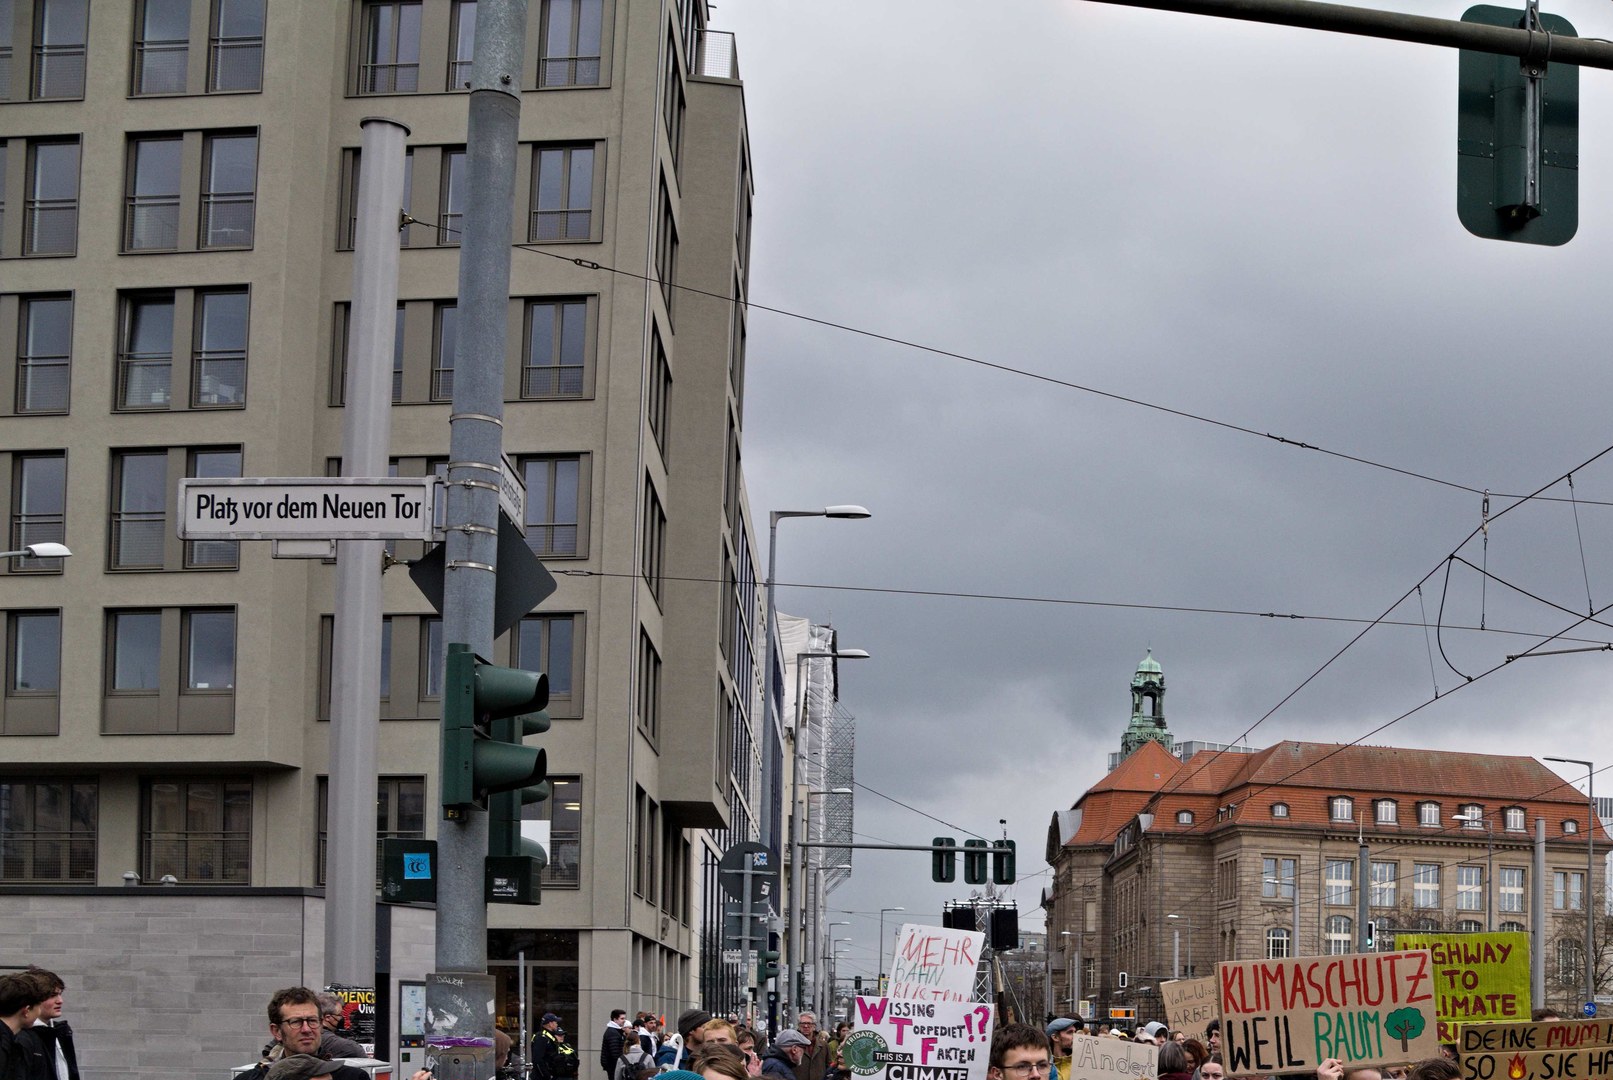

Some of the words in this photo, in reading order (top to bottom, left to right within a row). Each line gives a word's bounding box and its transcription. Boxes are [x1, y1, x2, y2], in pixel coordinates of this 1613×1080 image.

[196, 493, 238, 525] Platz
[243, 498, 272, 519] vor
[276, 493, 317, 519] dem
[322, 493, 386, 519] Neuen
[391, 493, 421, 519] Tor
[902, 932, 975, 969] MEHR
[894, 957, 944, 986] BAHN
[1222, 952, 1433, 1014] KLIMASCHUTZ
[1442, 969, 1479, 990] TO
[856, 997, 935, 1025] WISSING
[1173, 1005, 1214, 1030] ARBEI
[1436, 994, 1517, 1018] IMATE
[846, 1031, 874, 1046] FRIDAYS
[874, 1034, 887, 1049] FOR
[1227, 1015, 1305, 1072] WEIL
[1313, 1010, 1384, 1066] BAUM
[1465, 1026, 1538, 1050] DEINE
[1546, 1023, 1600, 1048] MUM
[875, 1053, 894, 1061] THIS
[896, 1053, 903, 1061] IS
[921, 1037, 975, 1065] FAKTEN
[1078, 1037, 1155, 1077] Ändert
[850, 1064, 880, 1075] FUTURE
[1540, 1053, 1577, 1080] SIE
